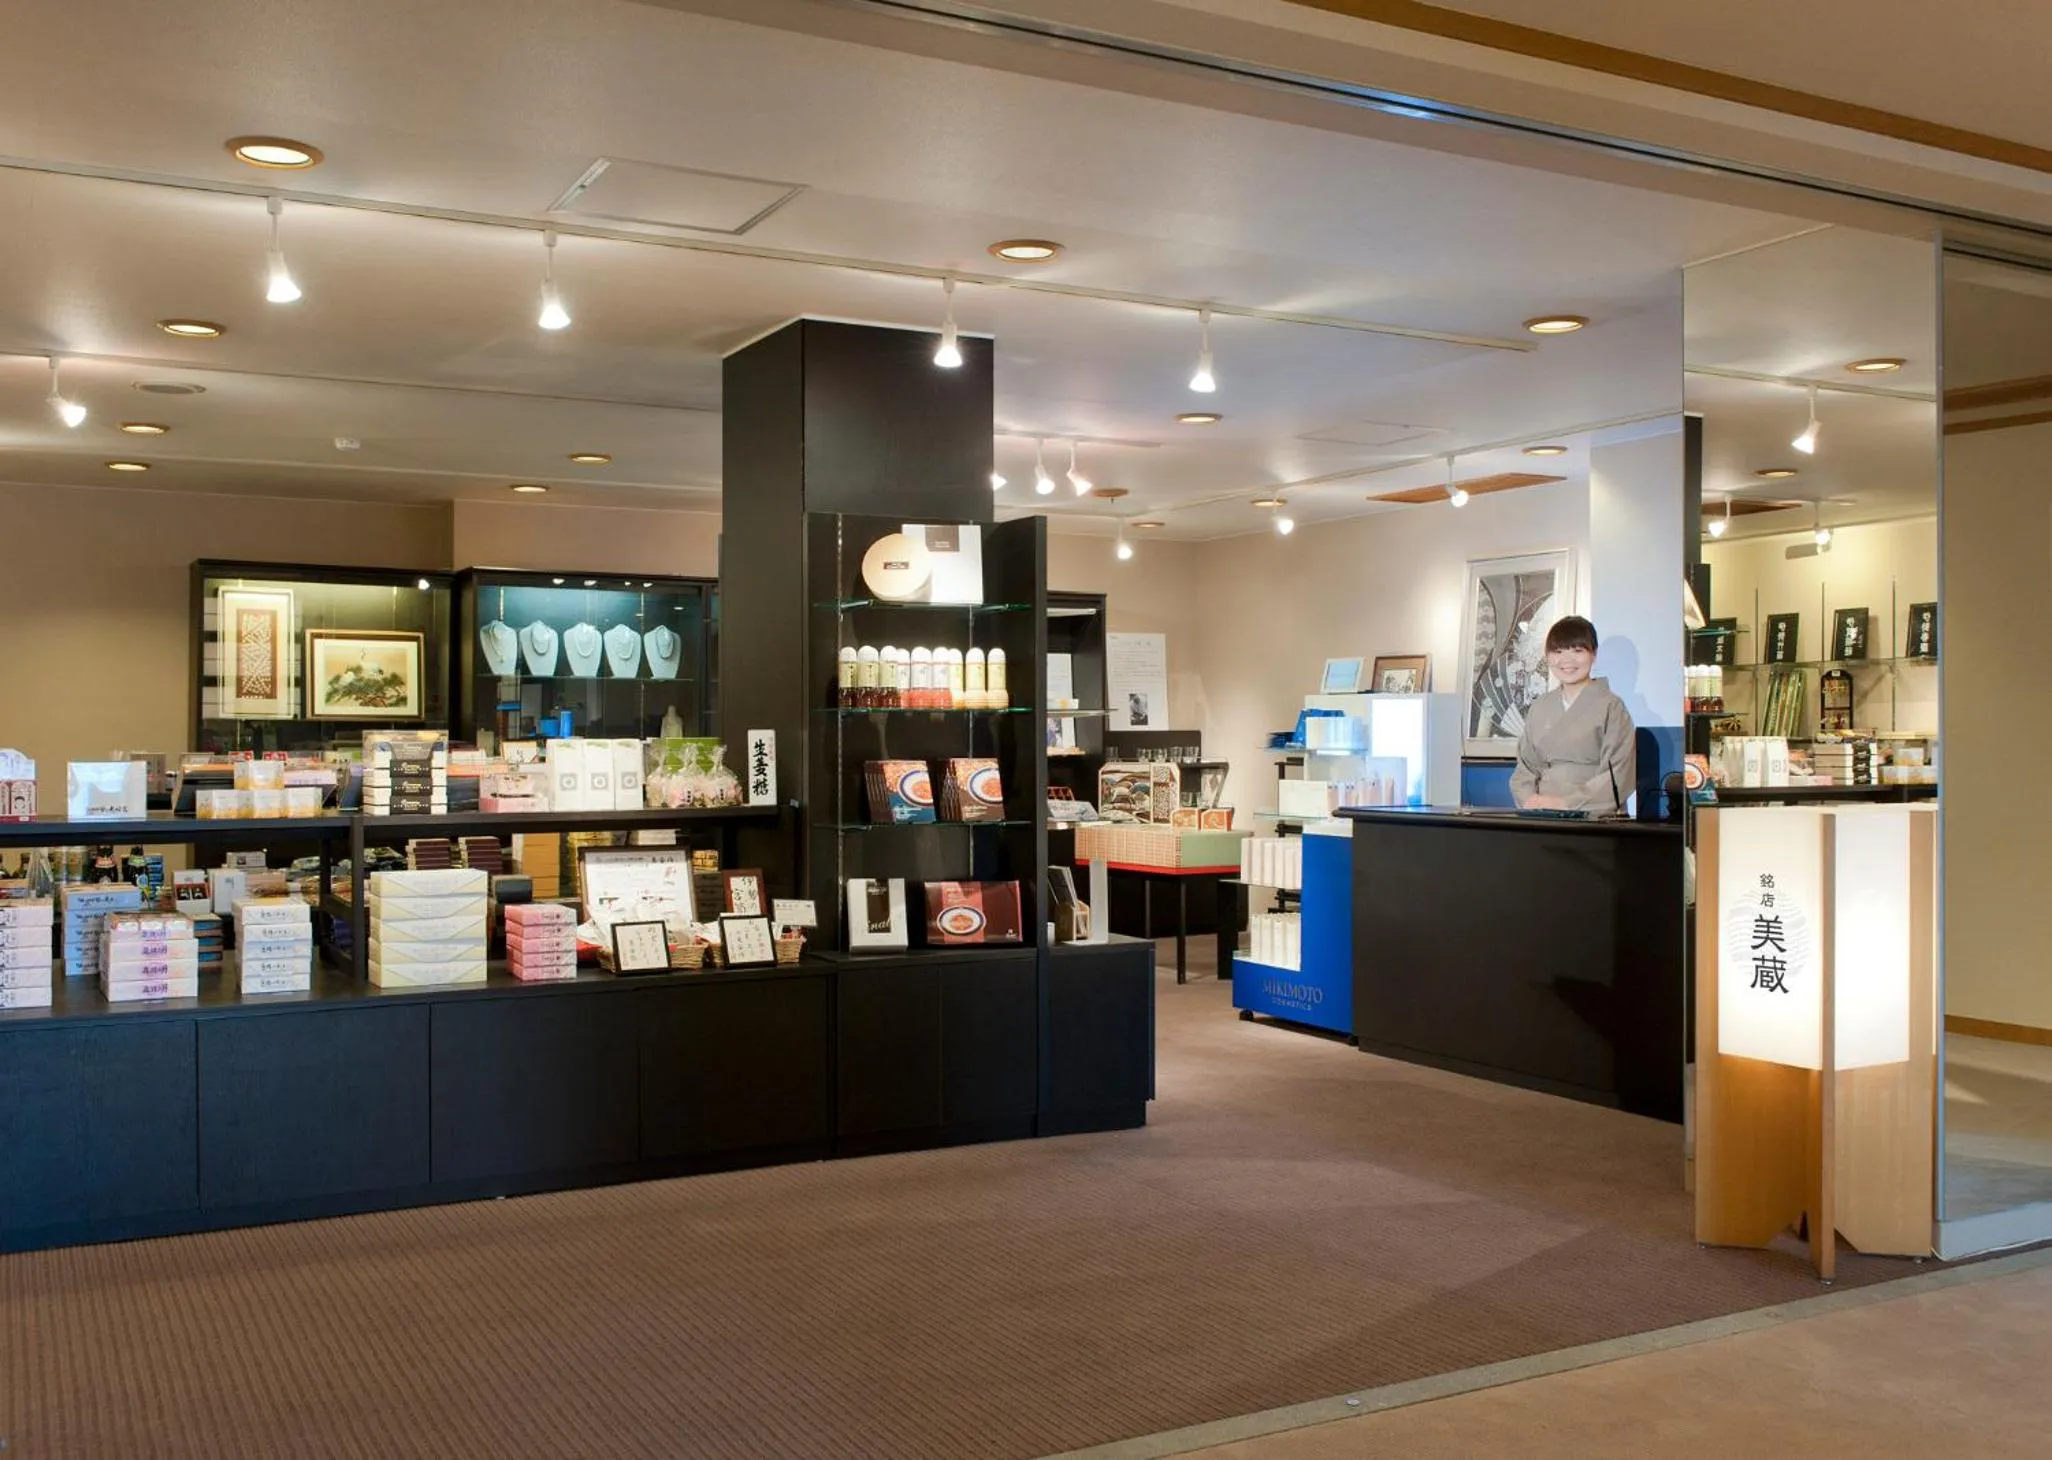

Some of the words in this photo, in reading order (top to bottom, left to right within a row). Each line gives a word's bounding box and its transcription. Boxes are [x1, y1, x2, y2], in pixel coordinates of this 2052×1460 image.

[752, 738, 769, 796] 生姜糖
[1759, 873, 1775, 908] 銘店
[1750, 913, 1790, 994] 美蔵
[1262, 980, 1323, 1003] MIKIMOTO
